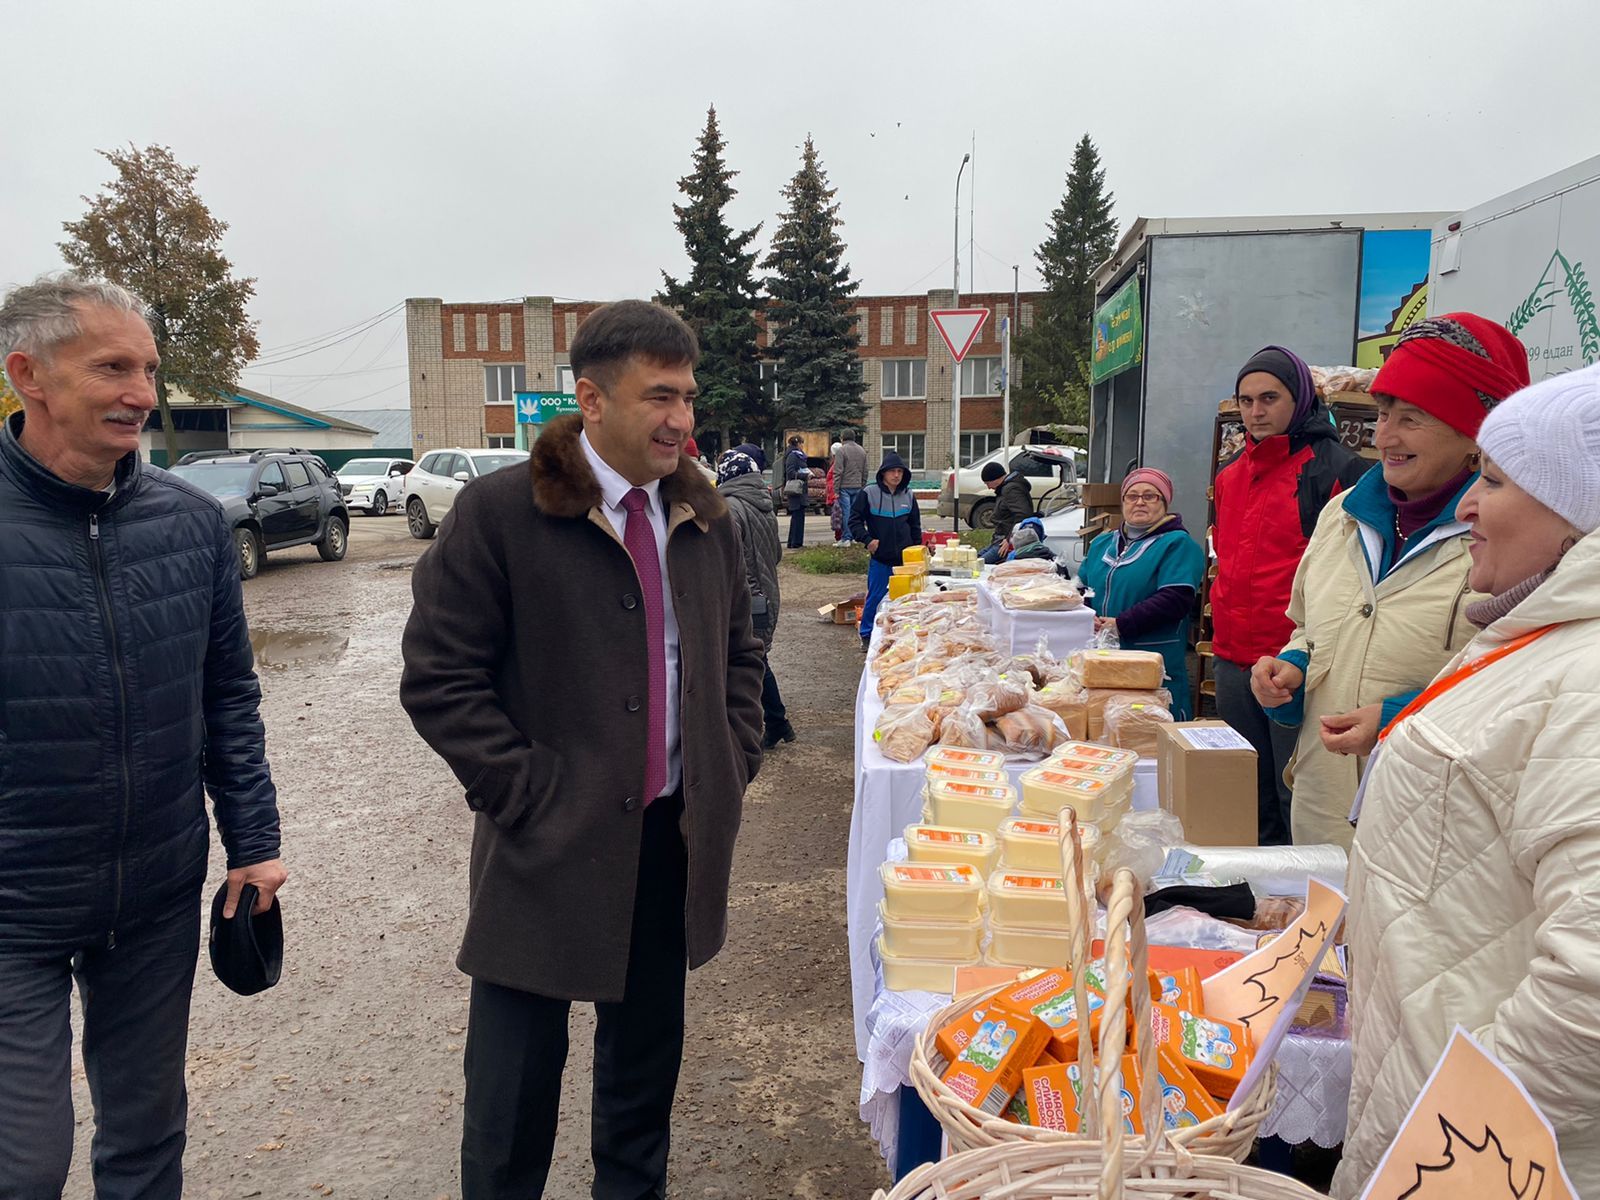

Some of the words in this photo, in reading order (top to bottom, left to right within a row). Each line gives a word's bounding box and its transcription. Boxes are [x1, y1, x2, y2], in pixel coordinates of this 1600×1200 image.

[1525, 346, 1540, 361] 99
[1543, 346, 1573, 360] елдан
[540, 398, 561, 406] ООО
[1340, 420, 1361, 447] 73
